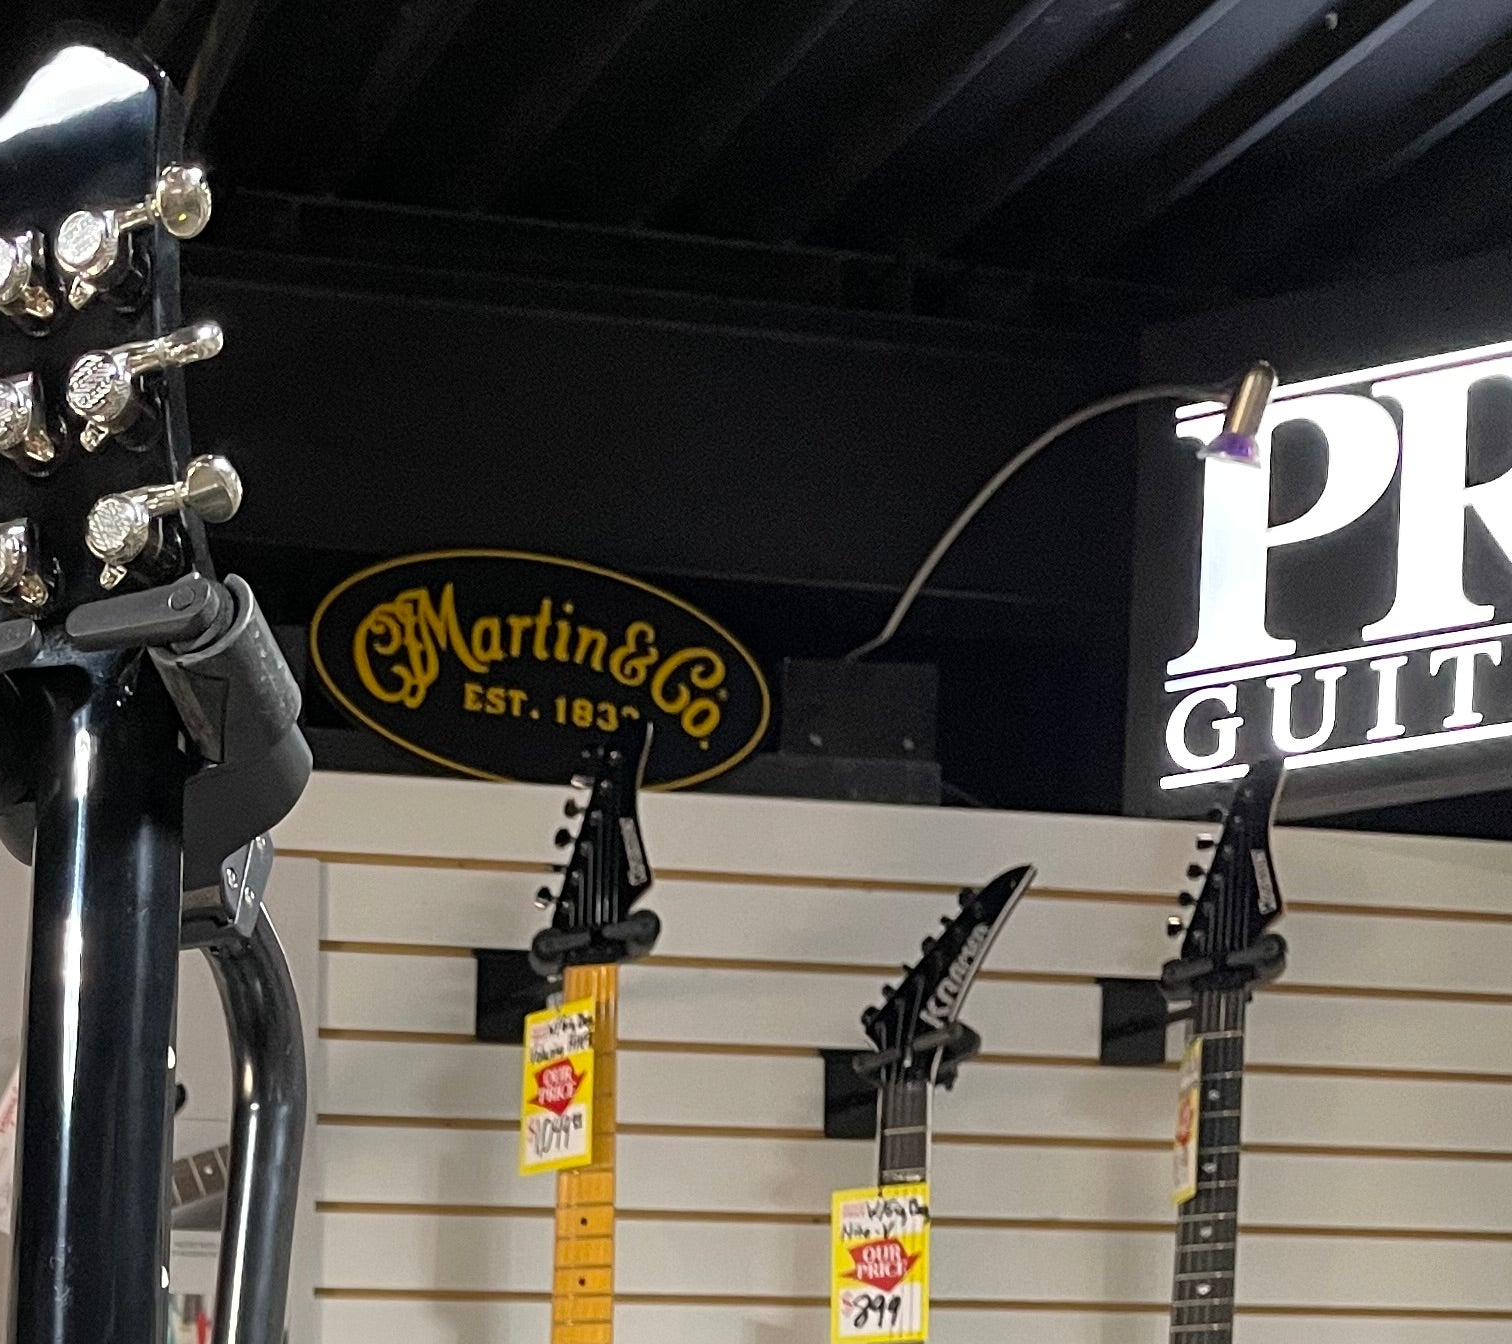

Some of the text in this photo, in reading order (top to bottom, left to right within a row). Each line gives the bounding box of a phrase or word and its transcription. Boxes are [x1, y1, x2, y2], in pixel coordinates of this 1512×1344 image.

[463, 682, 540, 719] EST.
[862, 1242, 902, 1265] OUR
[856, 1260, 909, 1281] PRICE
